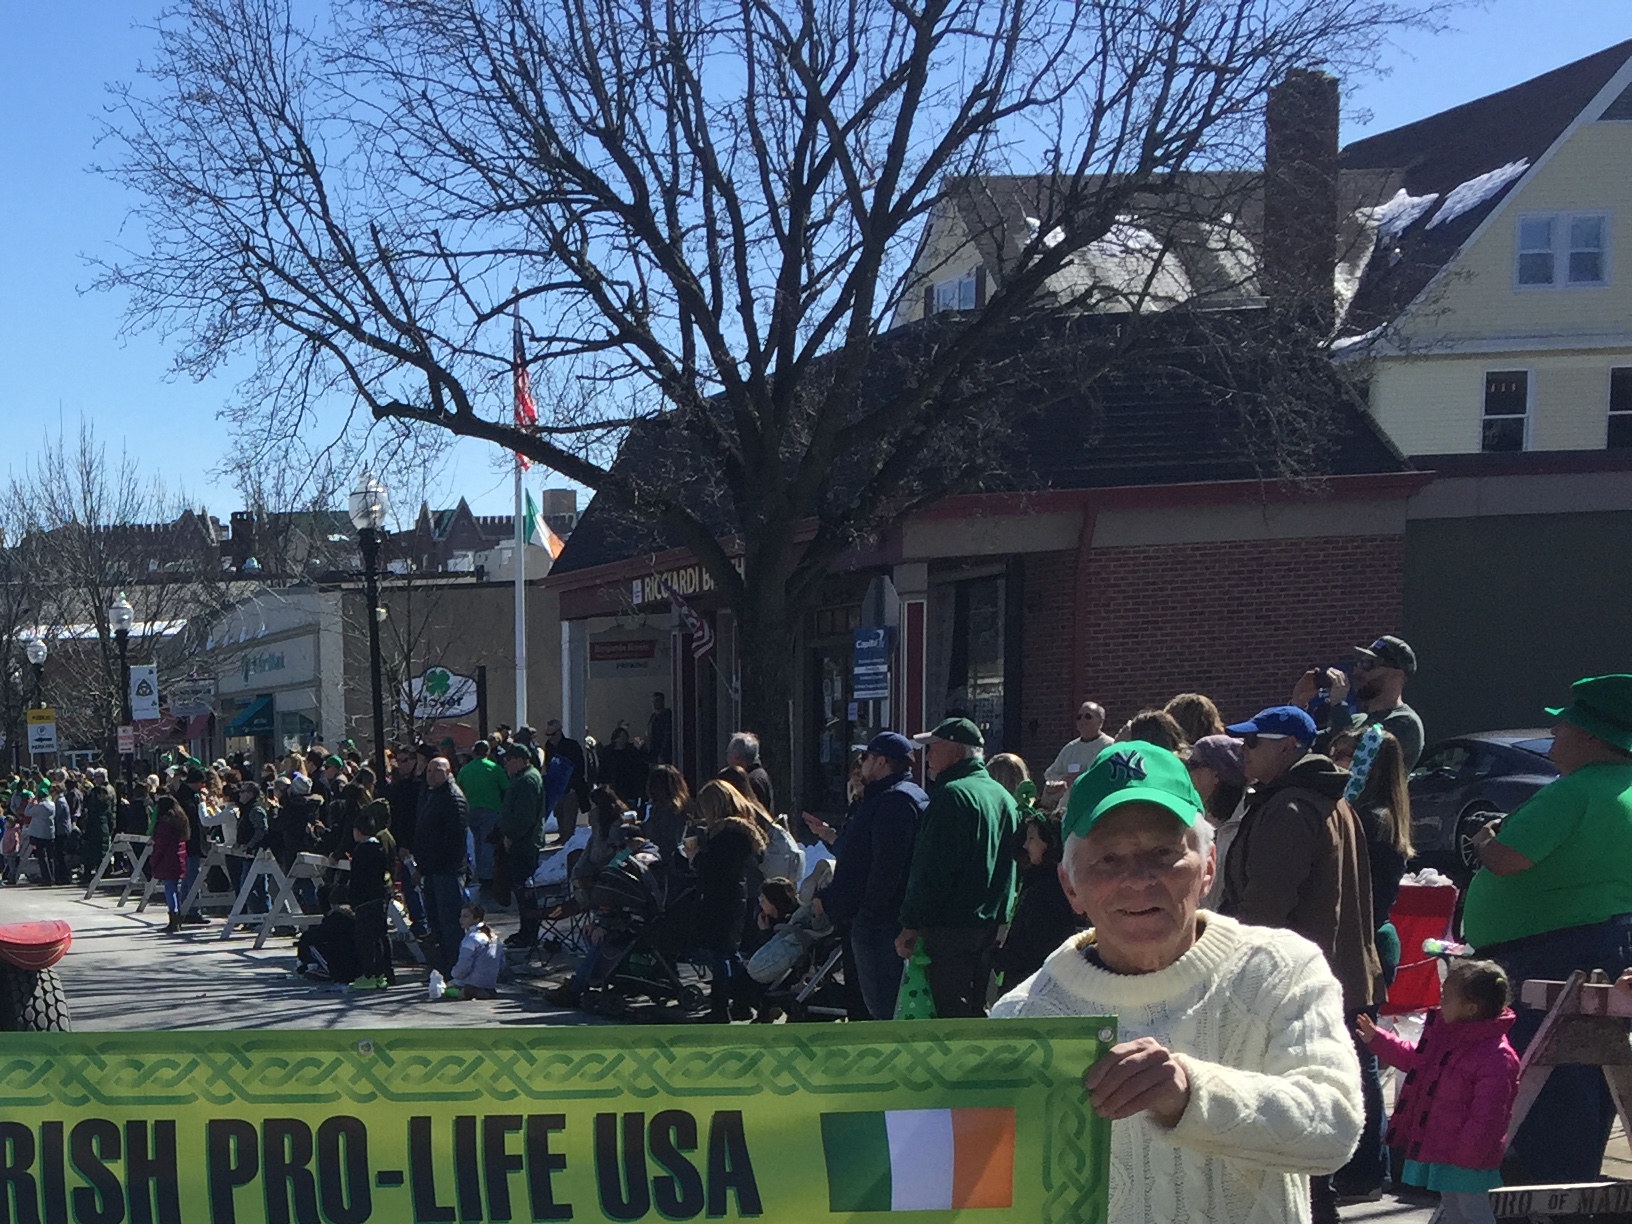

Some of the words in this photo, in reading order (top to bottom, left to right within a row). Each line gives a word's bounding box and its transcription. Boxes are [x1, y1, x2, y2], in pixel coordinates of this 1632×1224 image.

[644, 566, 699, 602] RICCIARDI
[594, 1109, 763, 1223] USA
[1547, 1194, 1569, 1210] OF
